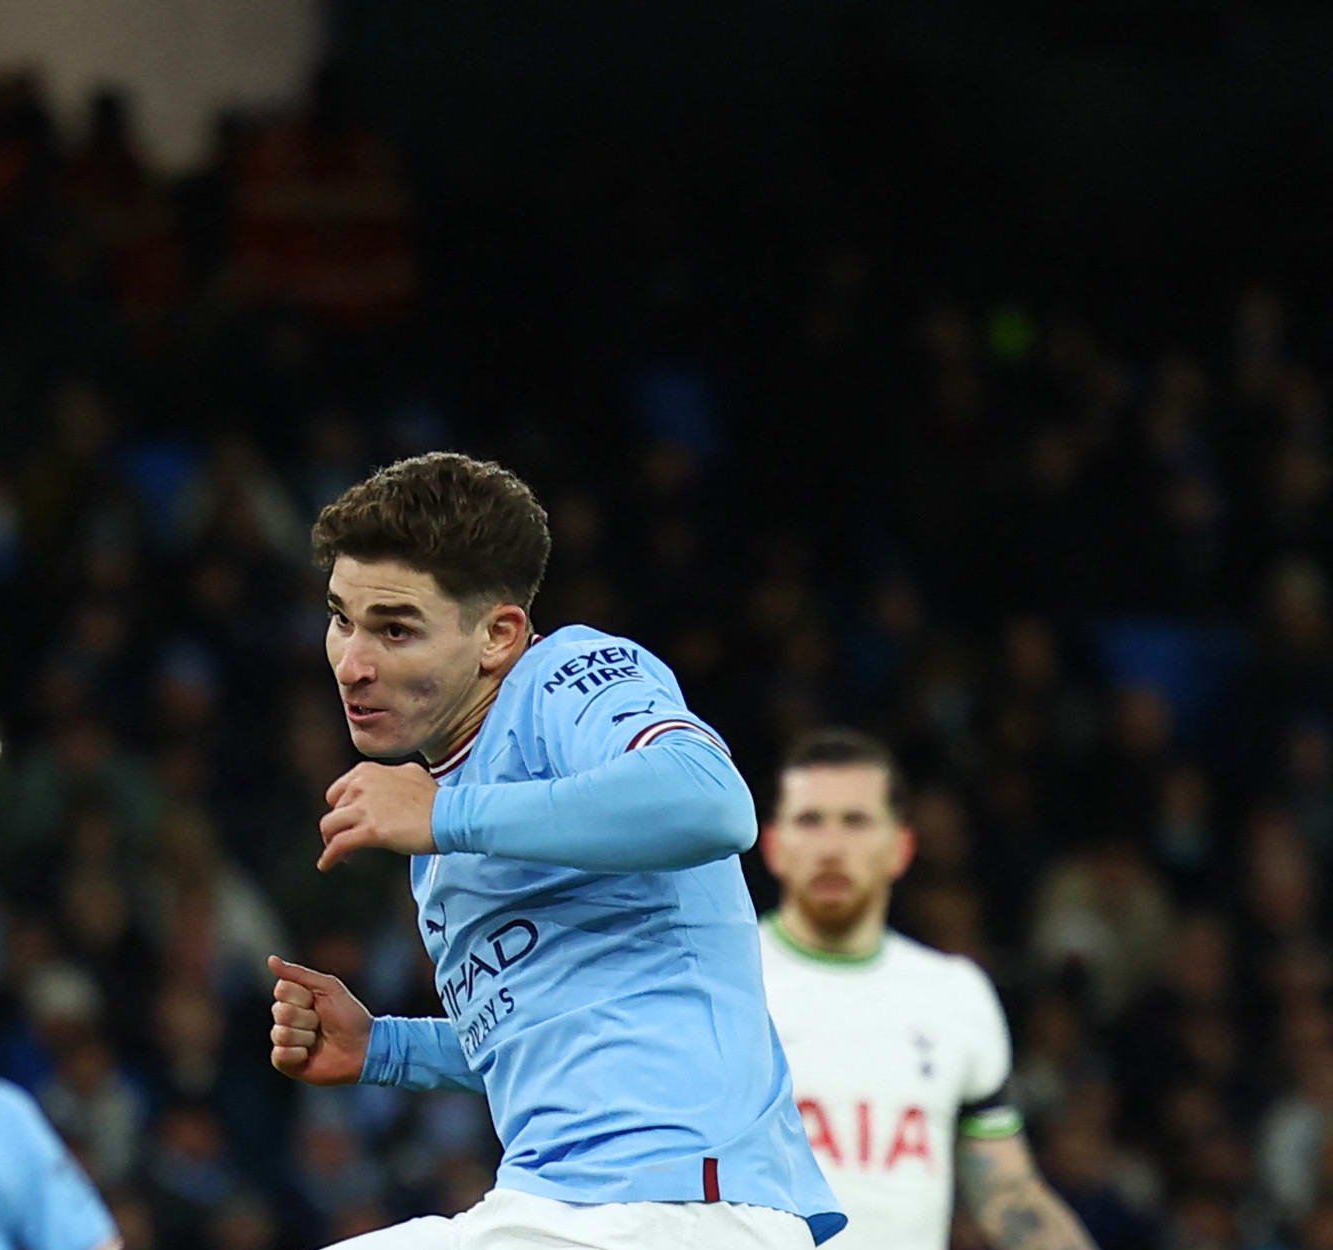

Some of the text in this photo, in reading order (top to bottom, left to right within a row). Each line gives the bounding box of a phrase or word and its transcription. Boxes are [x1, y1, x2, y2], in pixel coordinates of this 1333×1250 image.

[543, 646, 639, 695] NEXEN
[567, 665, 644, 695] TIRE
[795, 1096, 935, 1172] AIA
